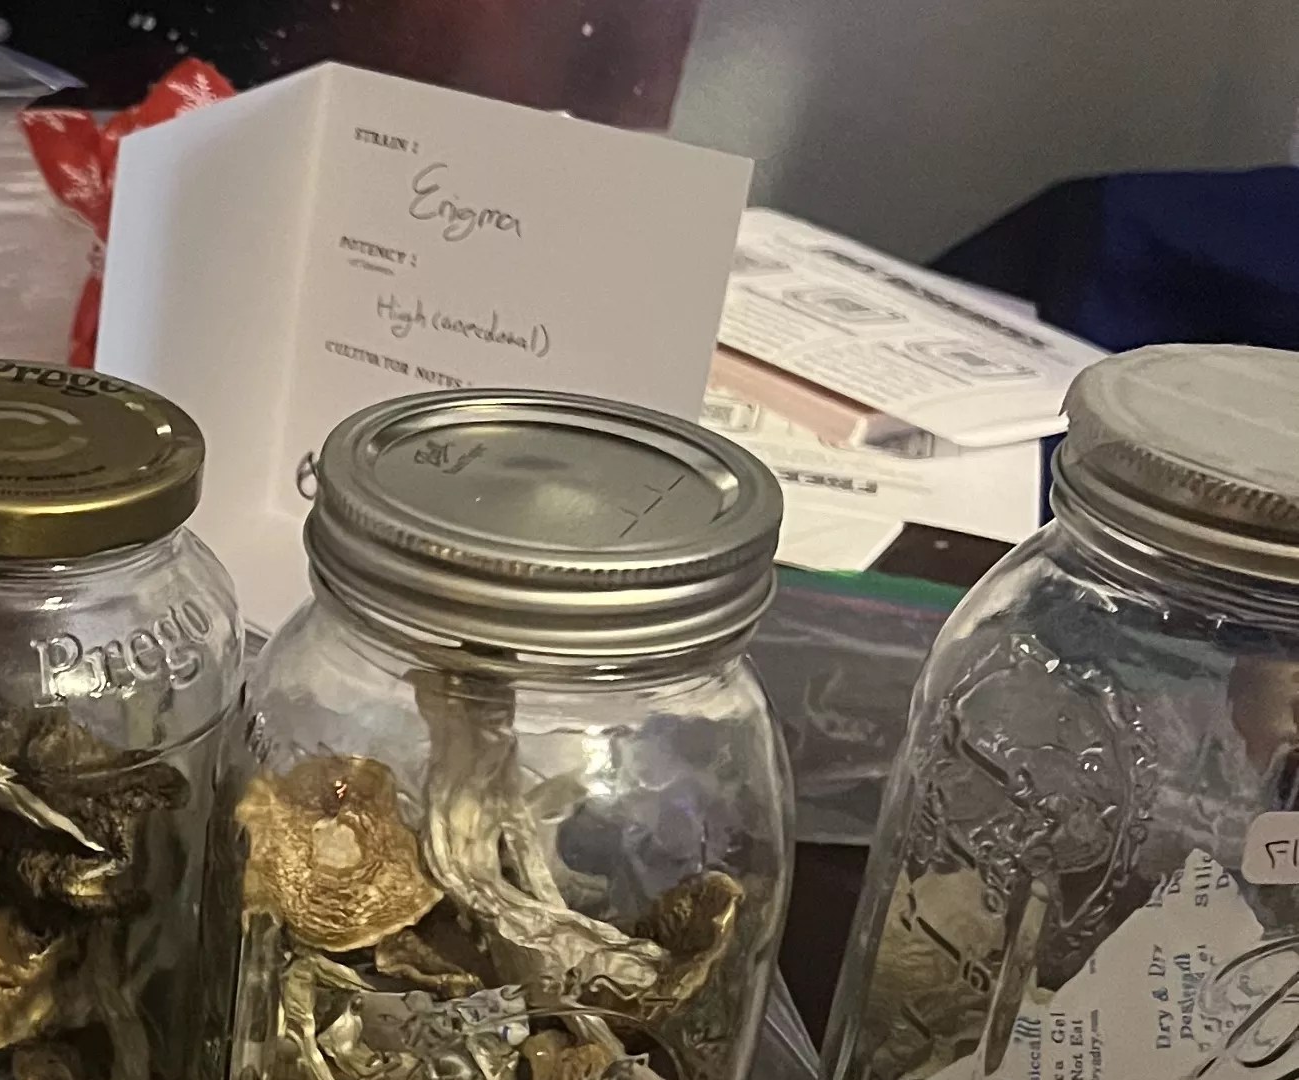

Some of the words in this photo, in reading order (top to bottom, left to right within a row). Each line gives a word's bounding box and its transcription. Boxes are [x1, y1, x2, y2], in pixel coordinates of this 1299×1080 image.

[409, 162, 521, 242] Enigma
[377, 293, 426, 338] High
[29, 598, 212, 708] Prego
[1051, 1012, 1066, 1044] Gel
